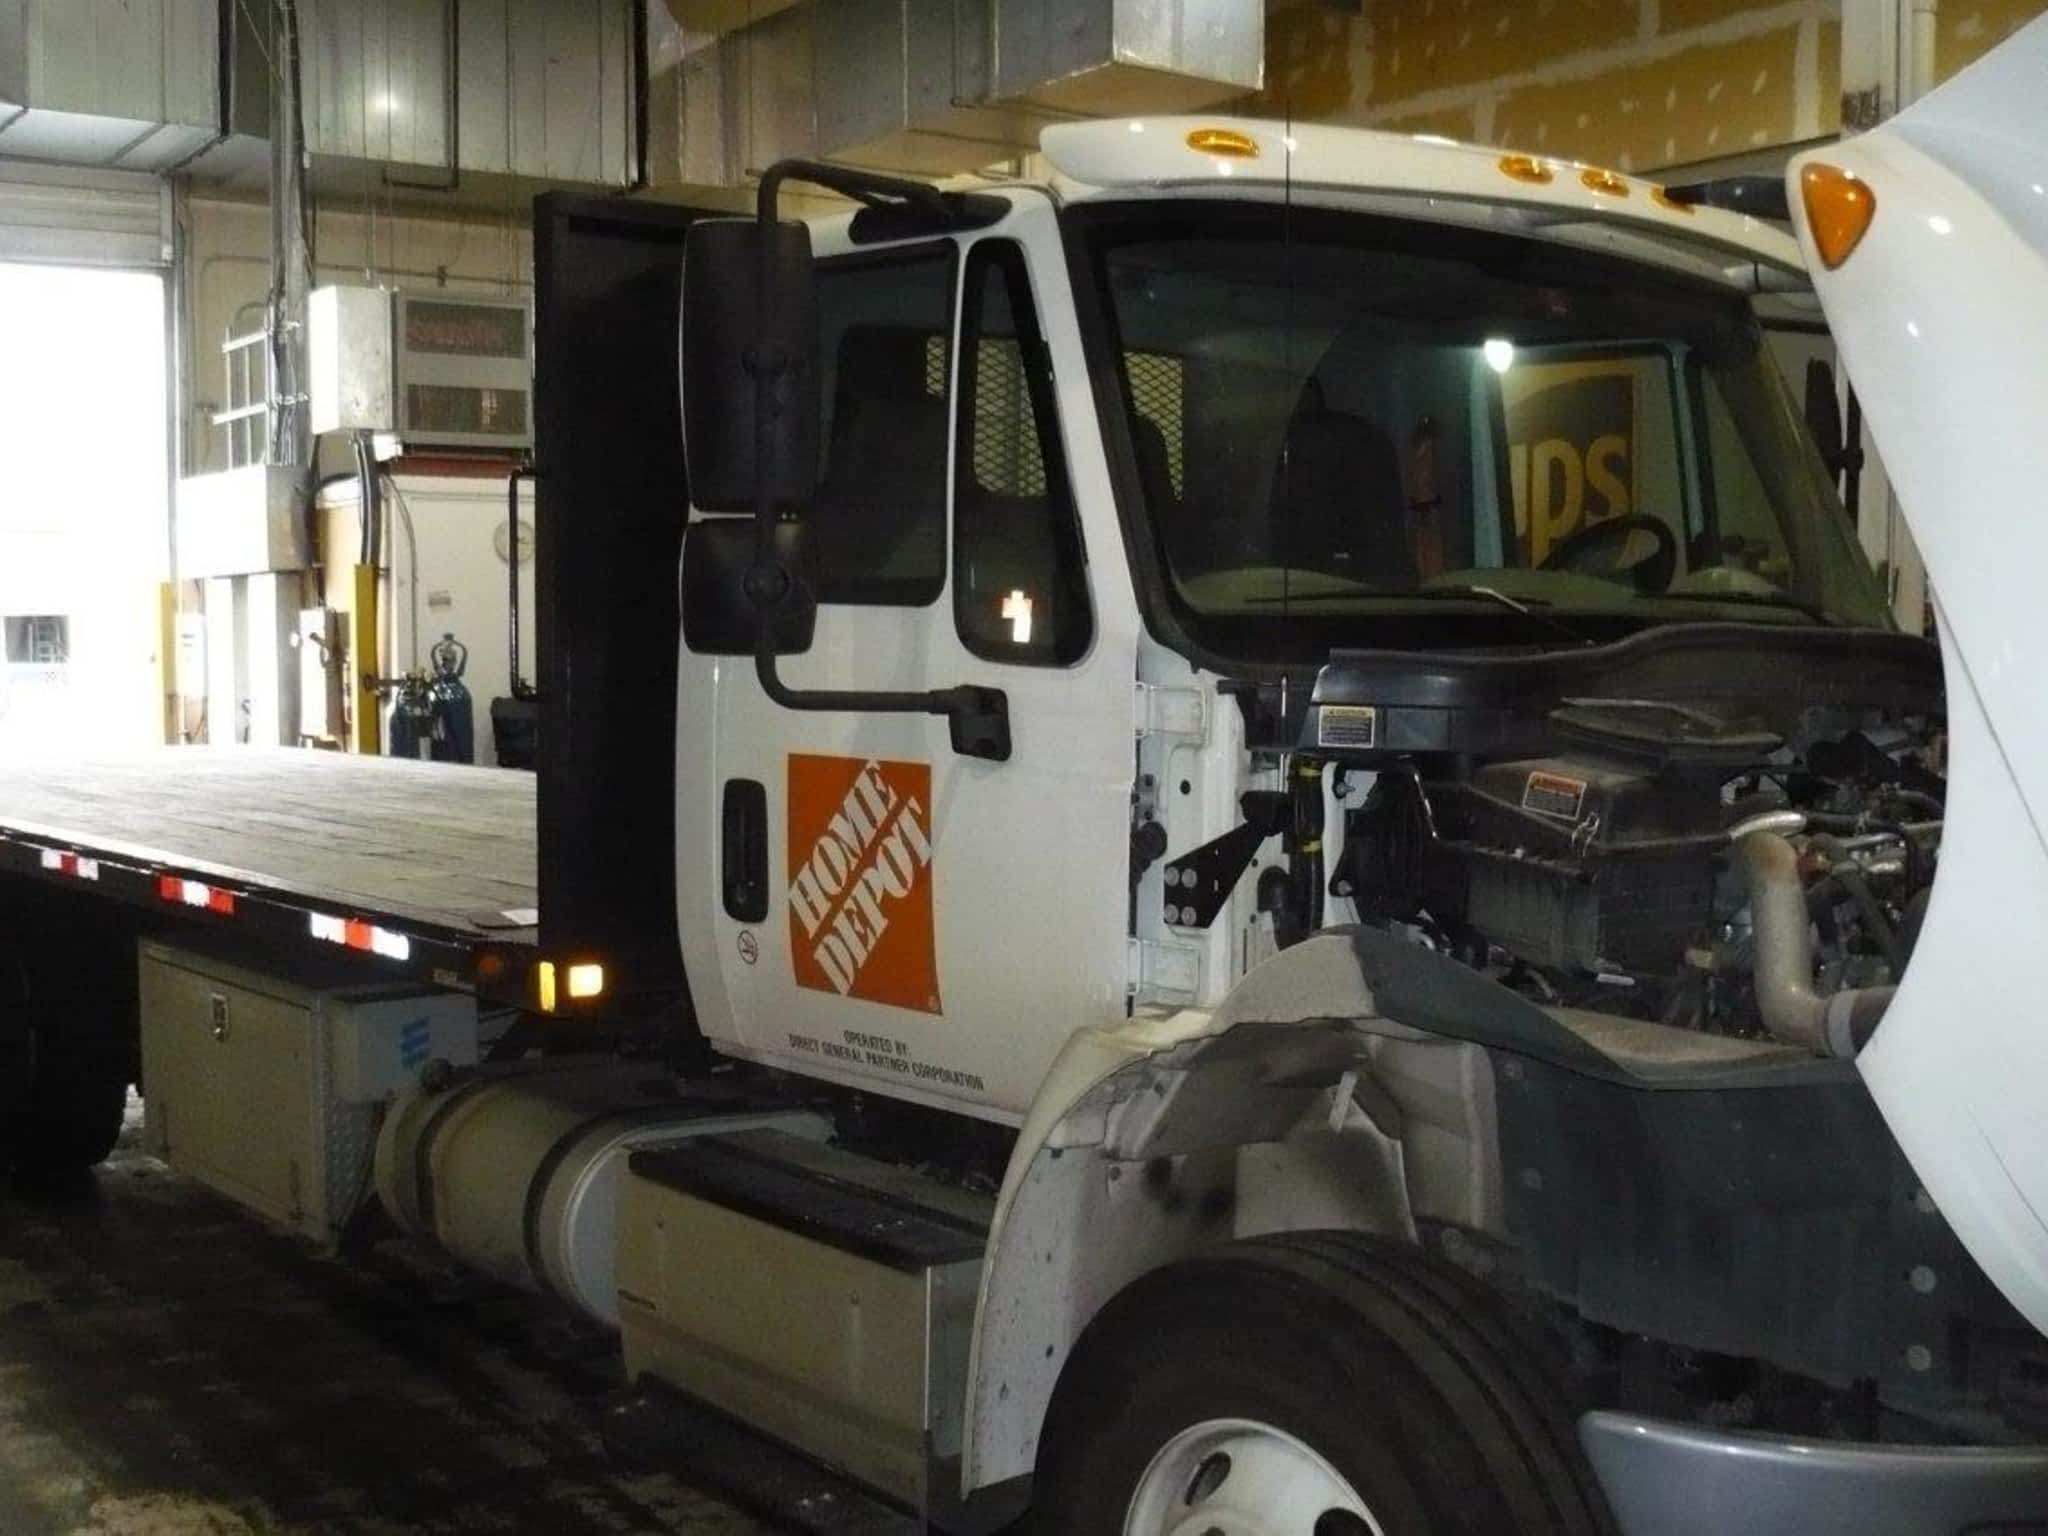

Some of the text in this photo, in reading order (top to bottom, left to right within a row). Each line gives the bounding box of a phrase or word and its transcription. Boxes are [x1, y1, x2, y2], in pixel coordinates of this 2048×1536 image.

[788, 759, 898, 940] HOME
[813, 796, 932, 996] DEPOT
[789, 1034, 984, 1090] DIRECT GENERAL PARTNER CORPORATION
[843, 1030, 891, 1053] OPERATED
